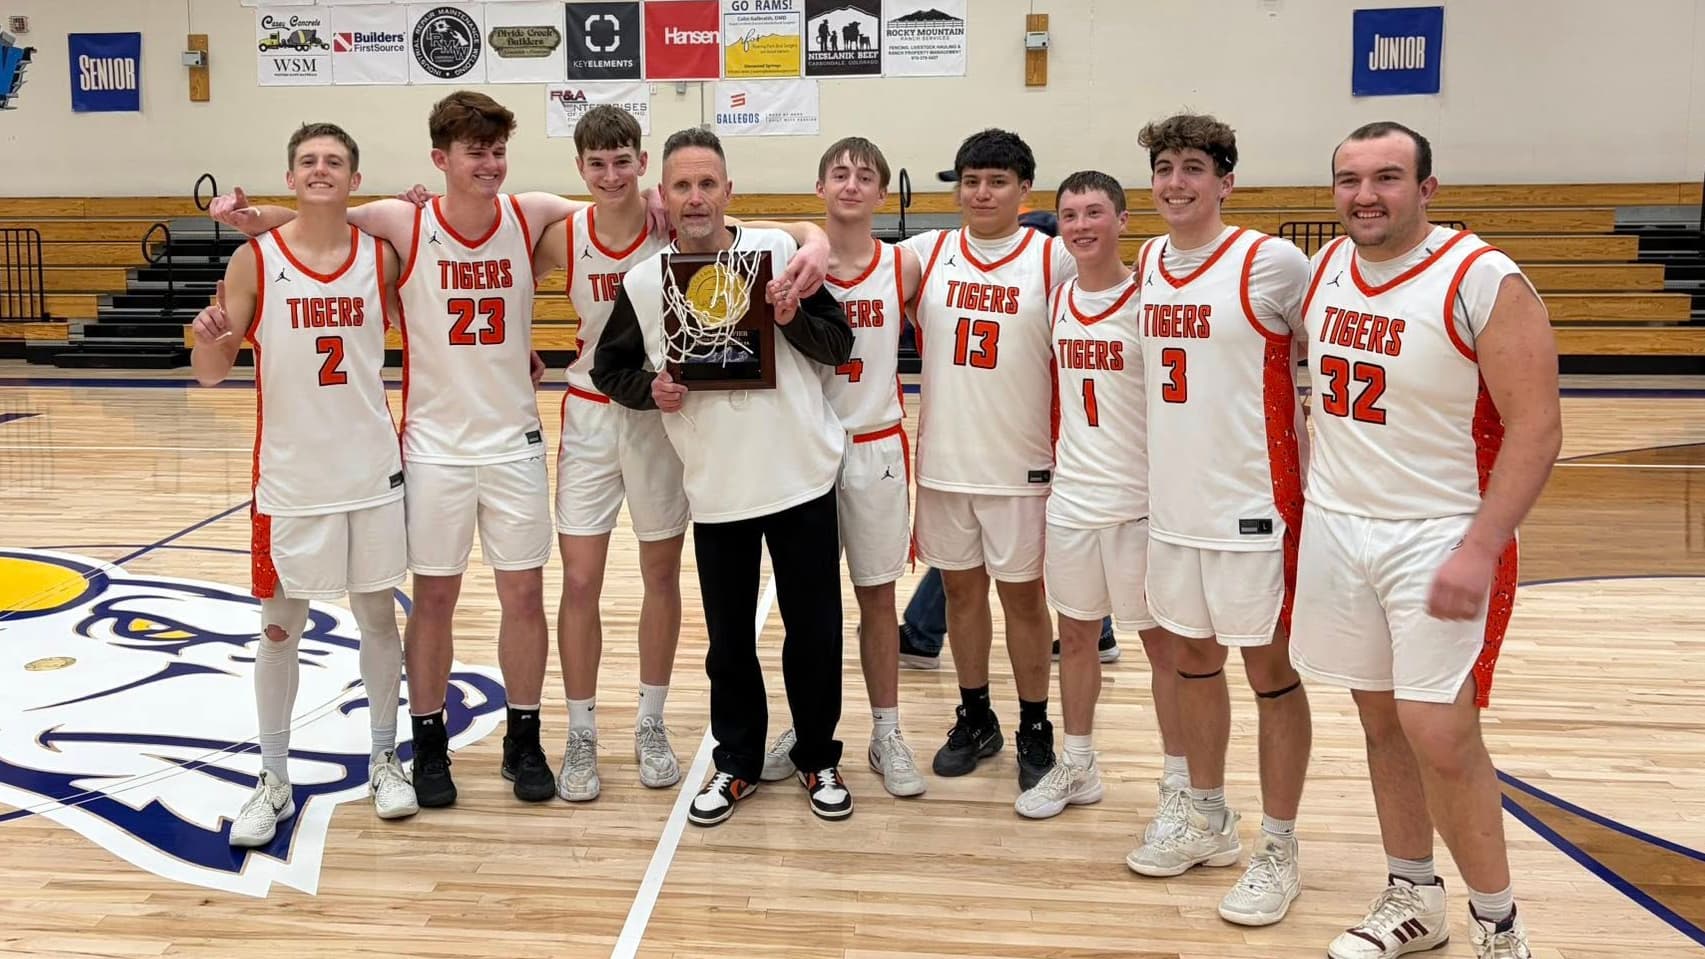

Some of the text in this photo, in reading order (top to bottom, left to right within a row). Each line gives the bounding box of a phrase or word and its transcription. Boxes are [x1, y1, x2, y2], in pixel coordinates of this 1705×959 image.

[731, 0, 793, 11] GO RAMS!
[290, 15, 321, 27] Concrete
[497, 28, 553, 37] Divide Creek
[664, 26, 720, 45] Hansen
[917, 28, 965, 36] MOUNTAIN
[354, 32, 404, 42] Builders
[354, 43, 405, 52] FirstSource
[273, 58, 317, 72] WSM
[808, 51, 879, 60] NIESLANIK BEEF
[550, 90, 587, 101] R&A
[716, 113, 760, 124] GALLEGOS
[437, 259, 513, 290] TIGERS
[588, 272, 629, 302] TIG
[286, 297, 364, 328] TIGERS
[946, 280, 1020, 315] TIGERS
[447, 297, 505, 345] 23
[837, 299, 885, 328] ERS
[1144, 304, 1211, 338] TIGERS
[953, 317, 1000, 369] 13
[1320, 306, 1406, 357] TIGERS
[316, 335, 347, 386] 2
[1058, 339, 1124, 371] TIGERS
[1162, 347, 1188, 404] 3
[1320, 354, 1387, 425] 32
[1082, 378, 1099, 427] 1
